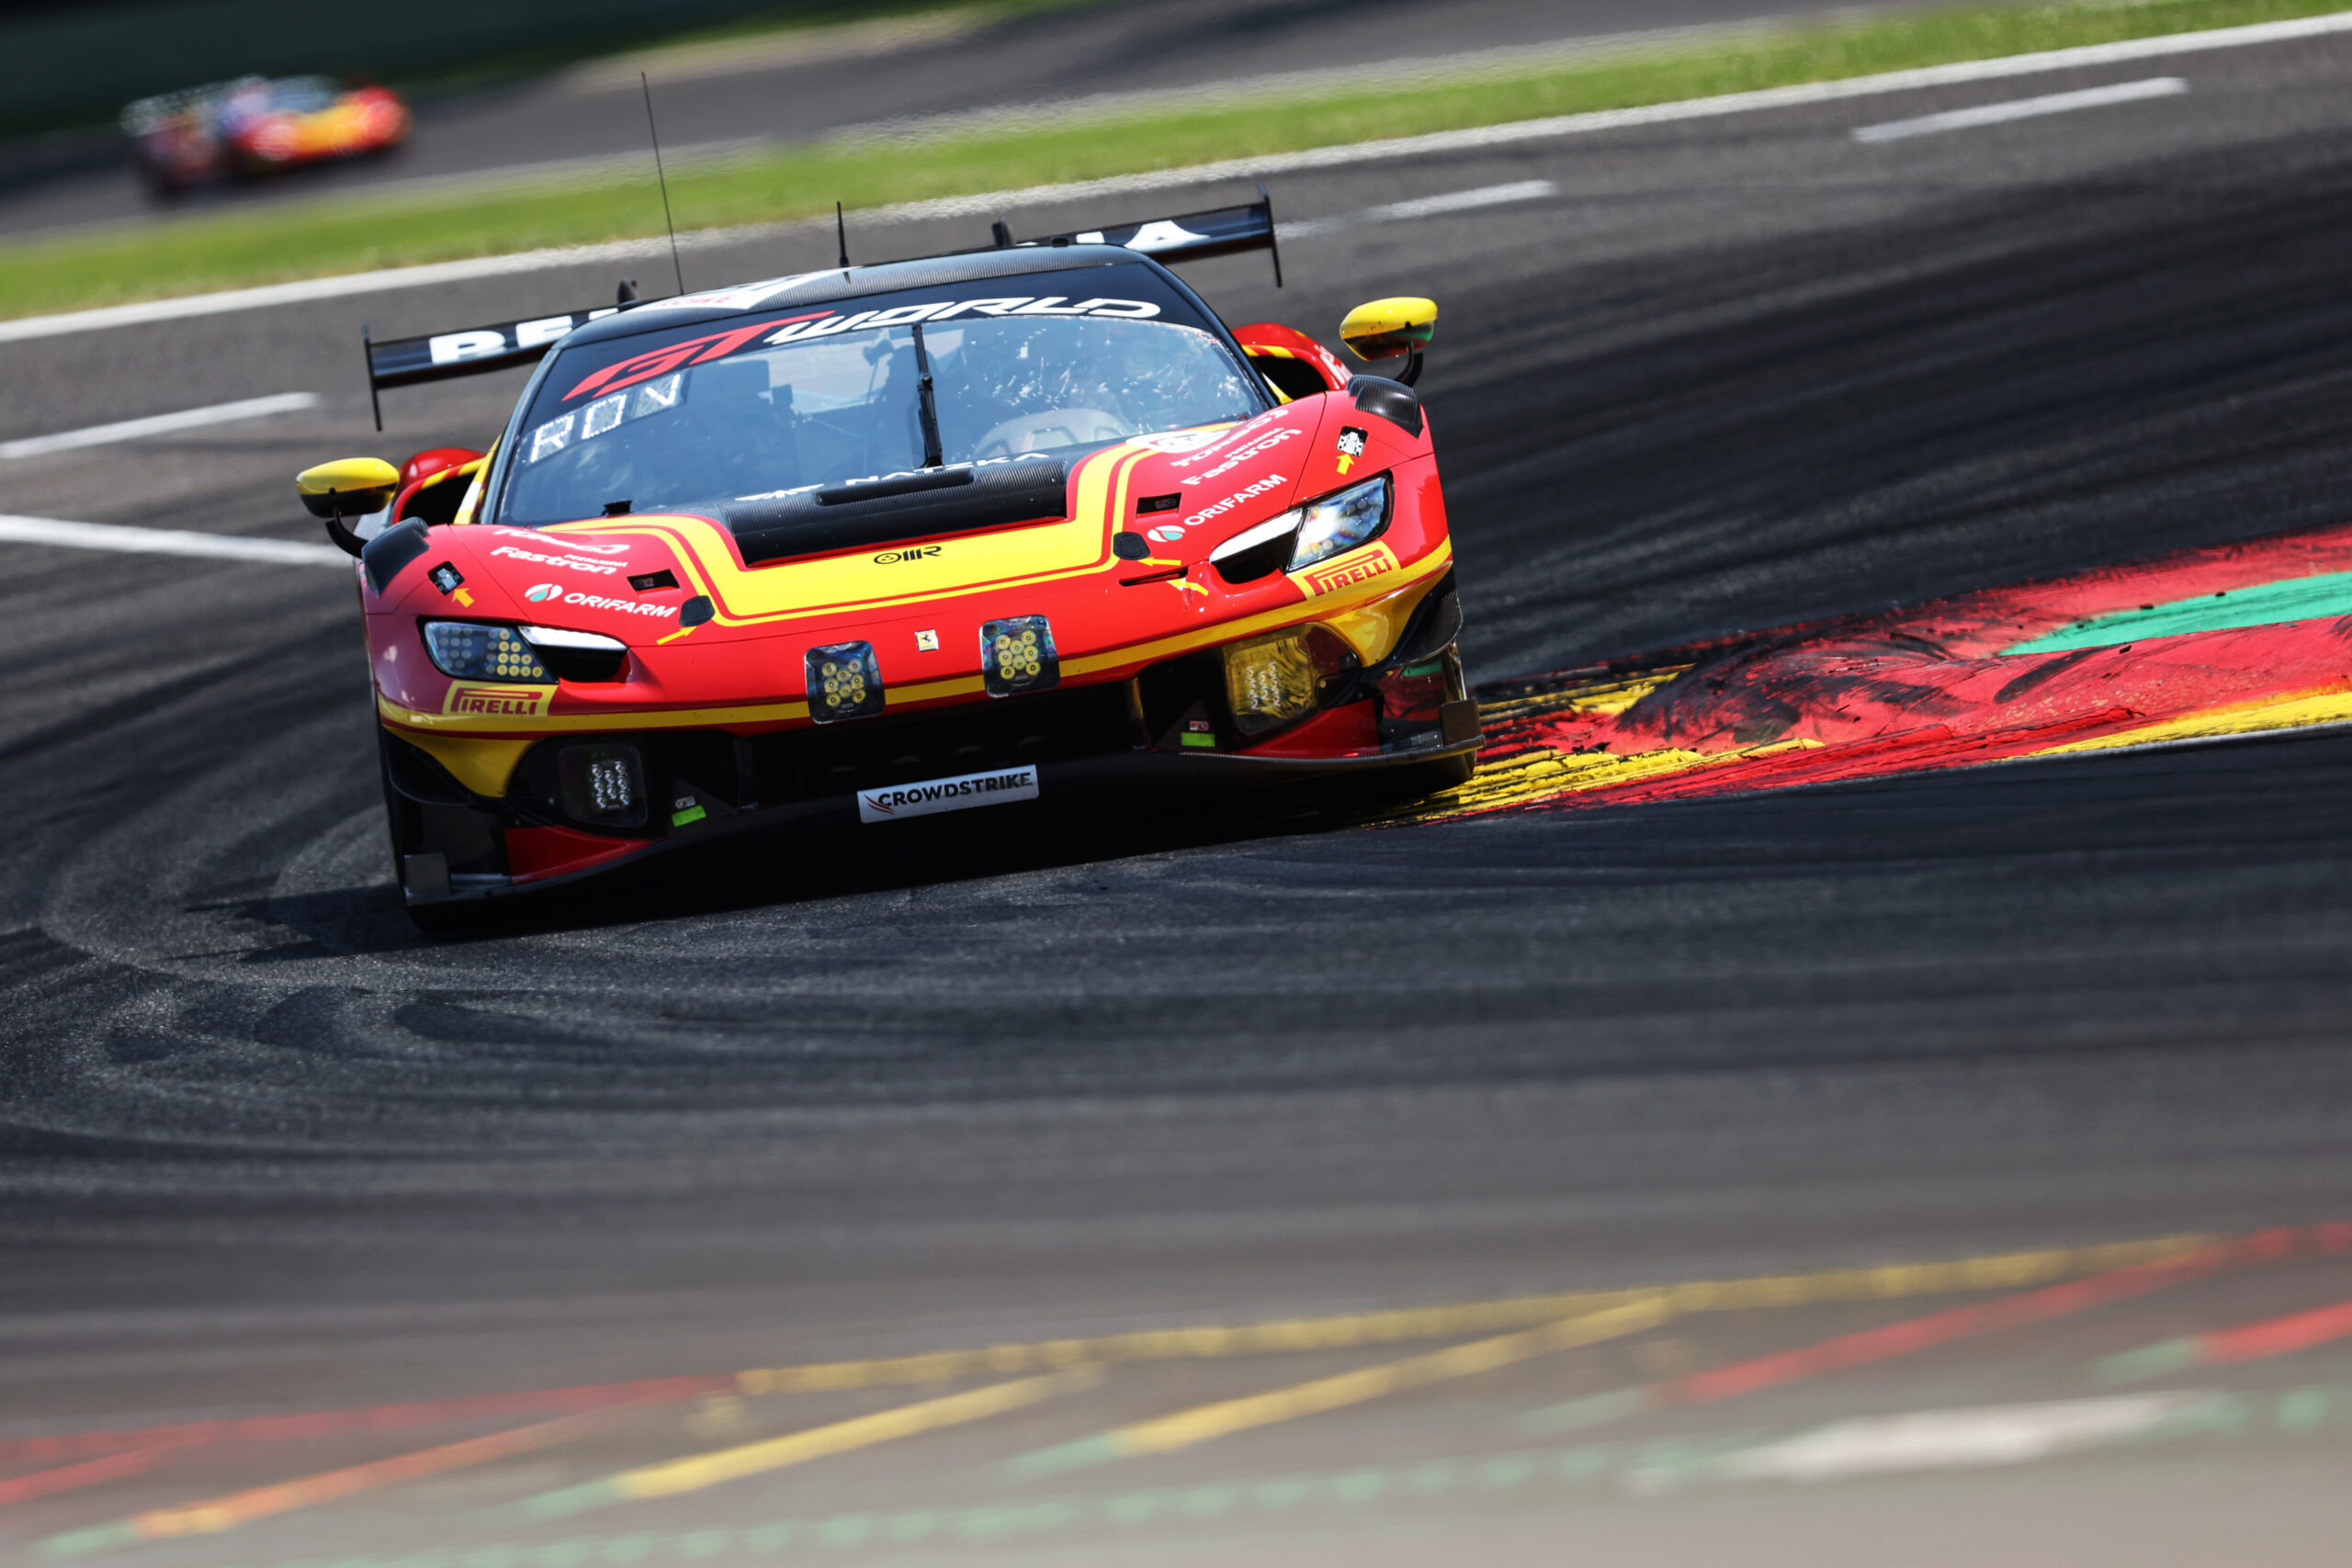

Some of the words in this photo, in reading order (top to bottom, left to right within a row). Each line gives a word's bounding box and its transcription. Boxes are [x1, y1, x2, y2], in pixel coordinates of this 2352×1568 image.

[763, 296, 1161, 344] WORLD
[1181, 428, 1302, 485] Fastron
[1184, 474, 1287, 525] ORIFARM
[491, 546, 616, 575] Fastron
[1304, 549, 1393, 596] PIRELLI
[564, 592, 677, 617] ORIFARM
[450, 687, 543, 716] PIRELLI
[878, 772, 1034, 807] CROWDSTRIKE
